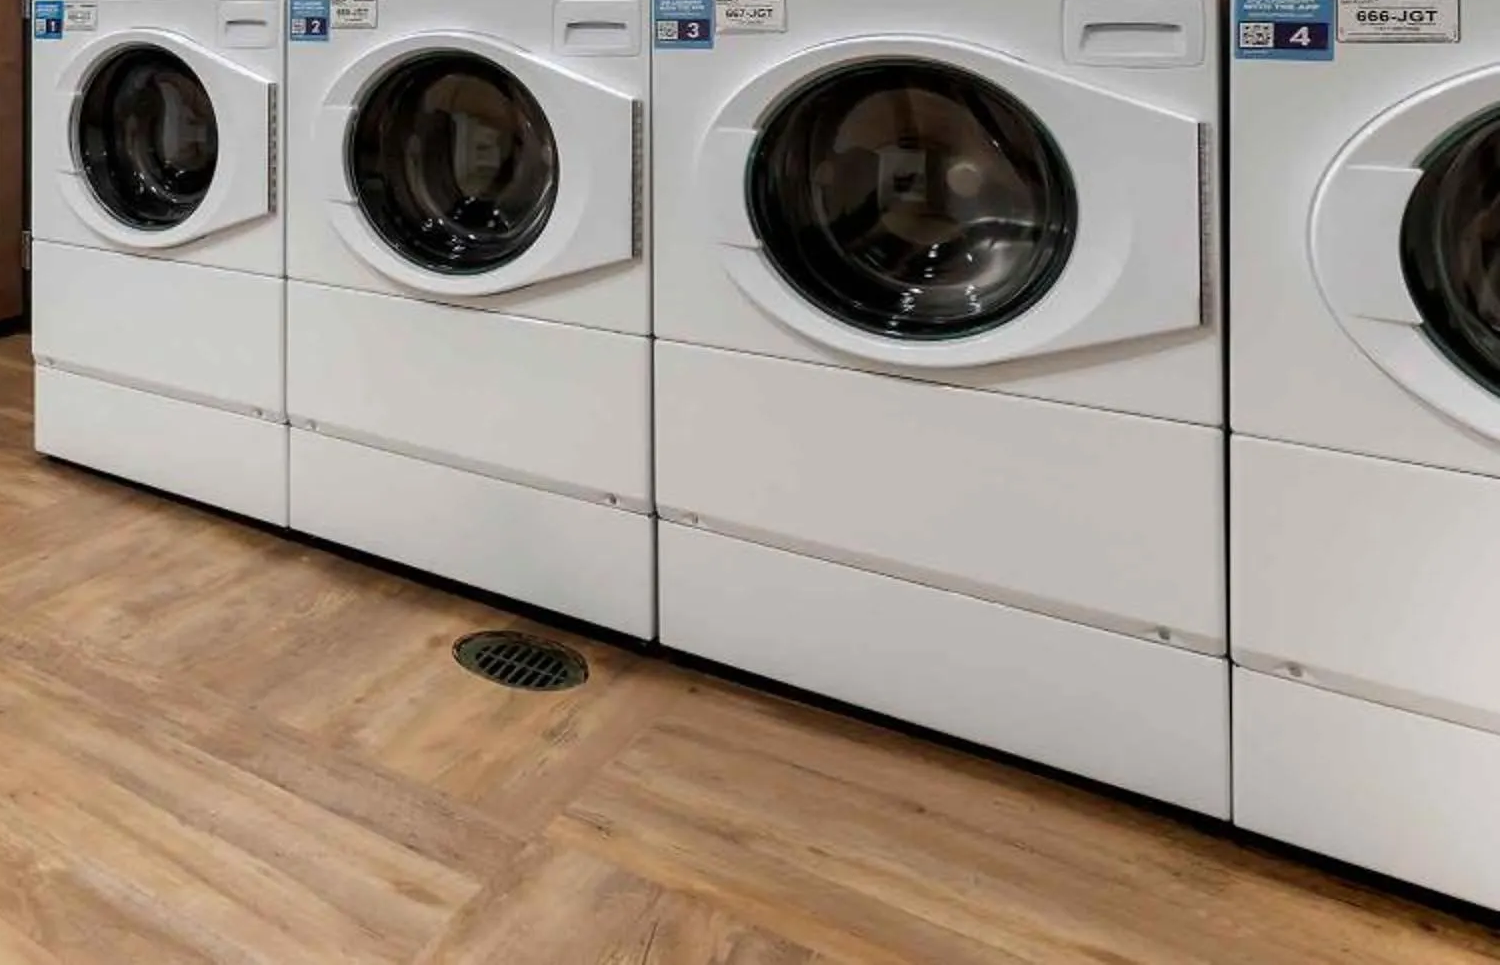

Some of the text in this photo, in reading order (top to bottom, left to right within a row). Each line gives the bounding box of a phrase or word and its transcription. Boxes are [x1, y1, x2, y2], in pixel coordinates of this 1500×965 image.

[1357, 10, 1438, 22] 666-JGT
[311, 20, 320, 34] 2
[686, 22, 700, 38] 3
[1289, 26, 1312, 46] 4
